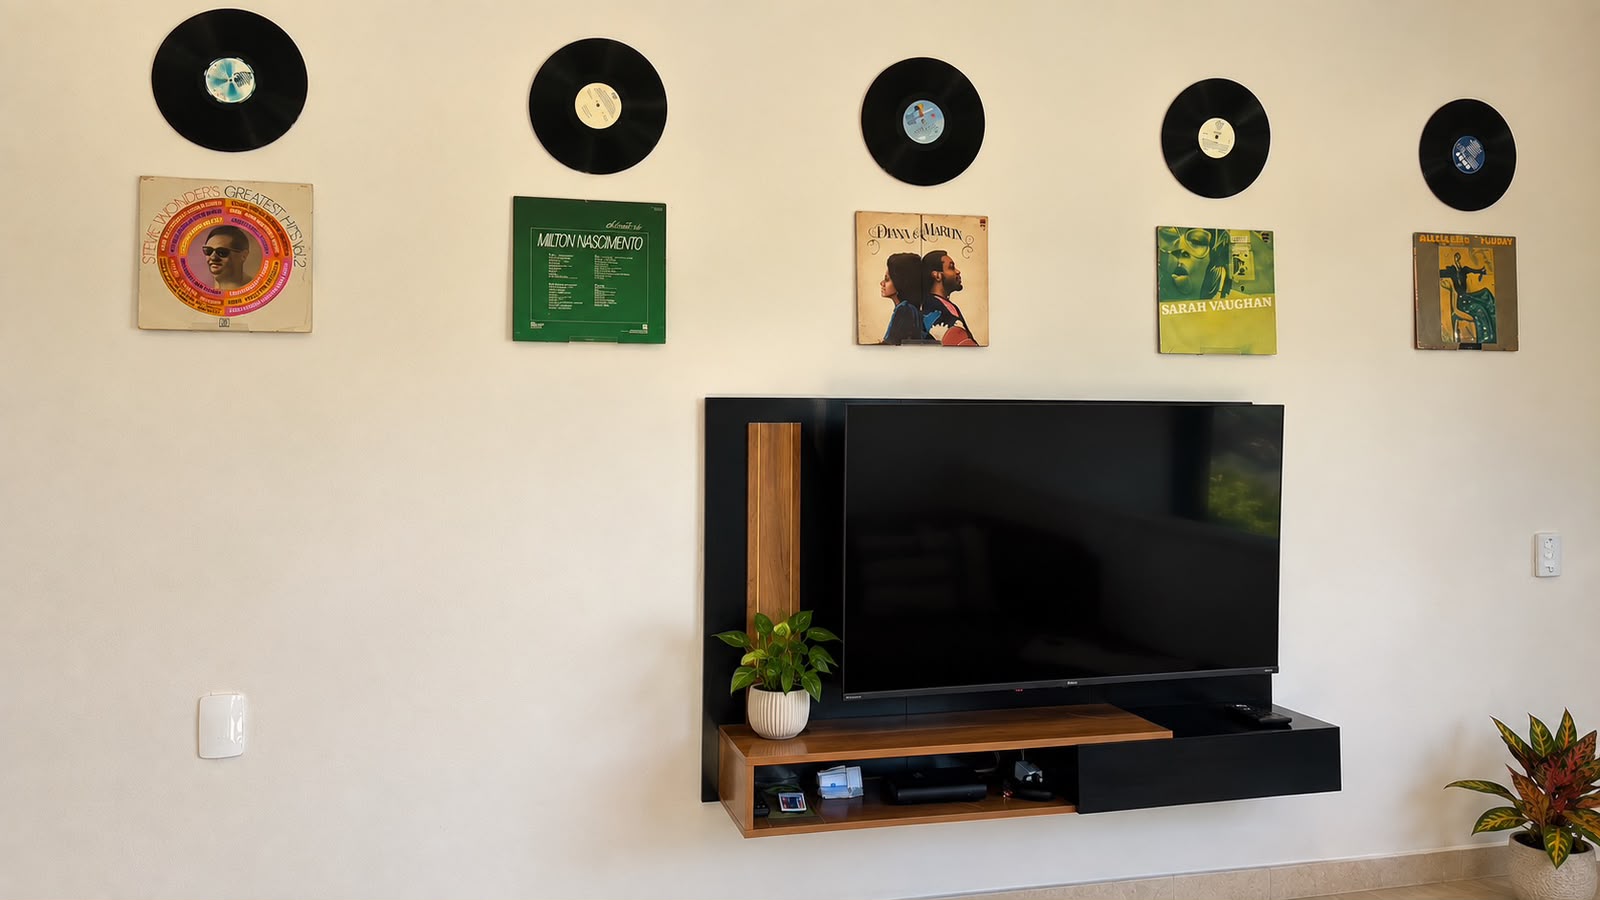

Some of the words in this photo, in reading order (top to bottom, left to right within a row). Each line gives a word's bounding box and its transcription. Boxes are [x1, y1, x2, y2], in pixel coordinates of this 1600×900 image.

[142, 224, 160, 265] STEVIE
[153, 185, 220, 224] WONDER'S
[224, 185, 286, 216] GREATEST
[280, 215, 302, 241] HITS
[537, 232, 576, 247] MILTON
[576, 234, 644, 251] NASCIMENTO
[1161, 302, 1207, 315] SARAH
[1209, 296, 1272, 311] VAUGHAN
